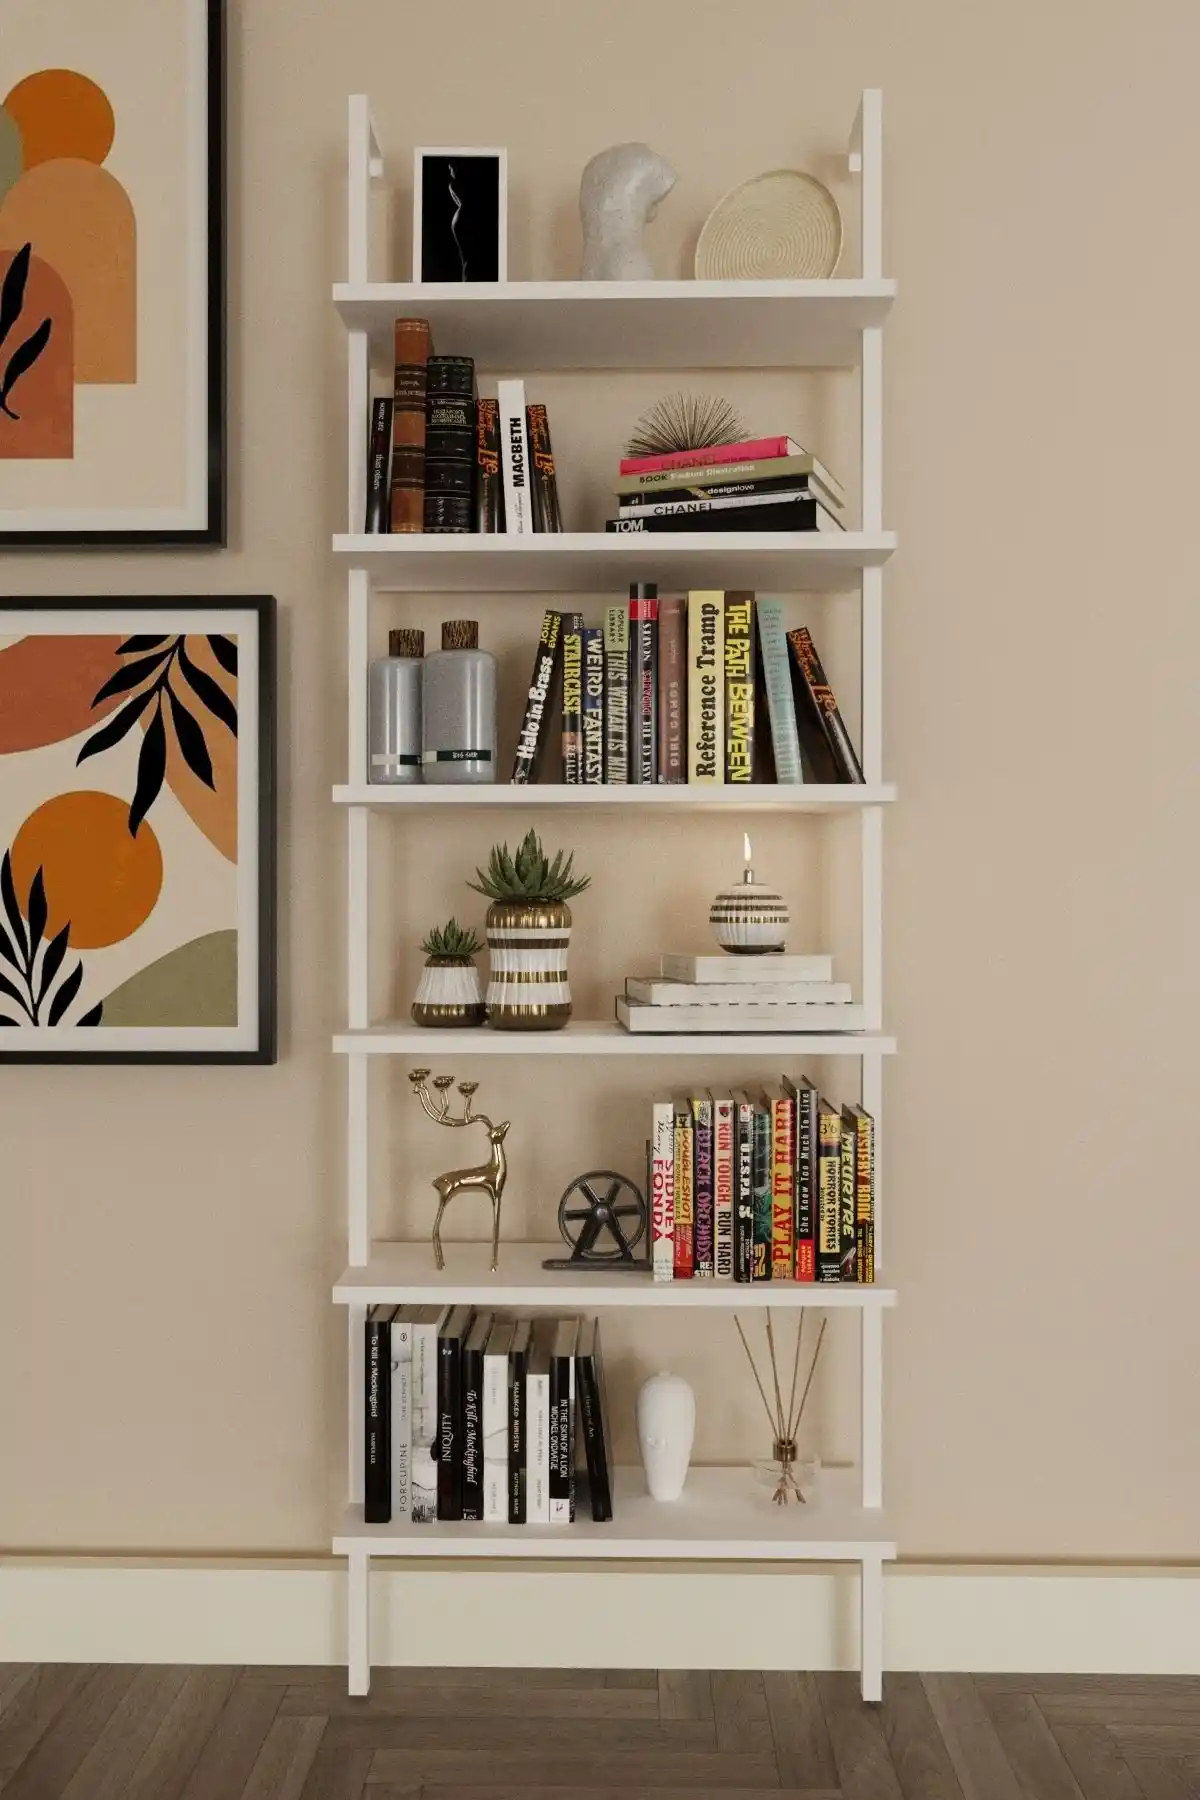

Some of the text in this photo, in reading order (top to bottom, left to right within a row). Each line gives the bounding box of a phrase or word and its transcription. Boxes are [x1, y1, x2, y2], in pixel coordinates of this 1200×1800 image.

[509, 417, 525, 488] MACBETH
[639, 474, 669, 484] BOOK
[706, 483, 755, 496] designlove
[613, 519, 644, 533] TOM
[540, 613, 553, 645] JOHN
[548, 615, 562, 649] EVANS
[617, 609, 625, 643] POPULAR
[563, 633, 582, 715] STAIRCASE
[607, 651, 627, 681] THIS
[696, 602, 720, 778] Reference Tramp
[725, 599, 754, 782] THE PATH BETWEEN
[516, 655, 554, 760] Halo in Brass
[583, 638, 603, 785] WEIRD FANTASY
[607, 686, 628, 732] WOMAN
[607, 738, 627, 753] IS
[669, 735, 680, 767] GIRL
[566, 744, 576, 784] REILLY
[800, 1093, 809, 1113] Live
[774, 1099, 793, 1165] HARD
[800, 1119, 809, 1130] To
[800, 1134, 809, 1159] Much
[857, 1118, 871, 1179] MYSTERY
[681, 1129, 692, 1223] DOUBLESHOT
[774, 1172, 792, 1196] IT
[841, 1133, 855, 1238] MEURTRE
[653, 1159, 664, 1242] FONDA
[665, 1159, 674, 1241] SIDNEY
[716, 1123, 731, 1275] RUN TOUGH, RUN HARD
[826, 1160, 836, 1250] HORROR STORIES
[696, 1191, 712, 1262] ORCHIDS
[773, 1204, 792, 1262] PLAY
[799, 1217, 809, 1233] She
[371, 1335, 378, 1345] To
[371, 1346, 379, 1359] Kill
[369, 1368, 379, 1417] Mockingbird
[467, 1390, 478, 1402] To
[560, 1399, 568, 1407] IN
[465, 1403, 478, 1422] Kill
[560, 1408, 568, 1423] THE
[442, 1412, 454, 1462] INIQUITY
[560, 1424, 568, 1441] SKIN
[560, 1442, 568, 1453] OF
[462, 1429, 478, 1485] Mockingbird
[550, 1435, 558, 1470] ONDAATJE
[560, 1460, 568, 1478] LION
[399, 1443, 407, 1512] PORCUPINE
